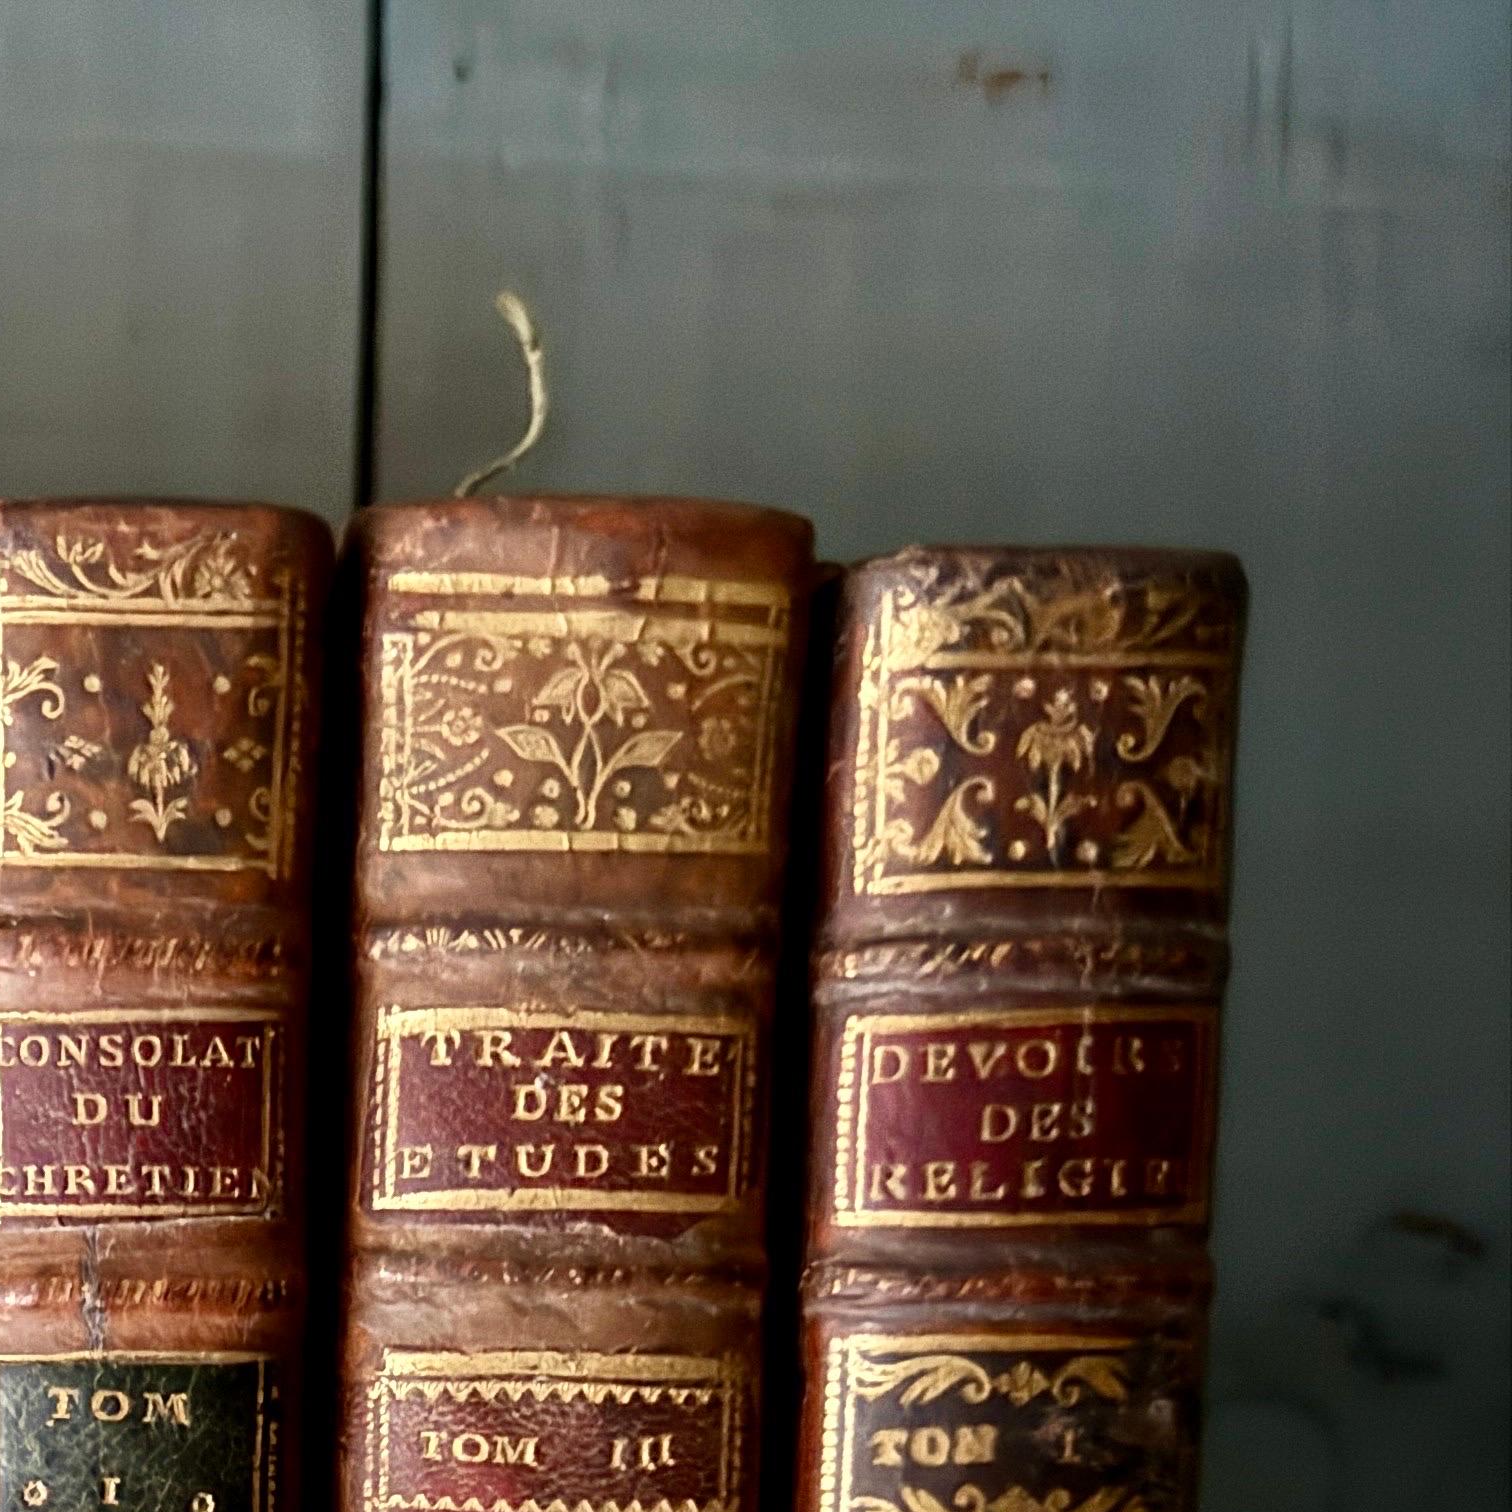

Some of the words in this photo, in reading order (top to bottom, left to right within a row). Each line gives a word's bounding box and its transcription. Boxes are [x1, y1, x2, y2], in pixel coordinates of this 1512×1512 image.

[71, 1092, 163, 1127] DU
[512, 1084, 625, 1124] DES
[979, 1098, 1096, 1143] DES
[397, 1141, 720, 1180] ETUDES
[45, 1386, 190, 1427] TOM
[420, 1430, 540, 1468] TOM
[610, 1432, 677, 1471] III
[870, 1424, 999, 1467] TOM
[100, 1476, 121, 1505] I
